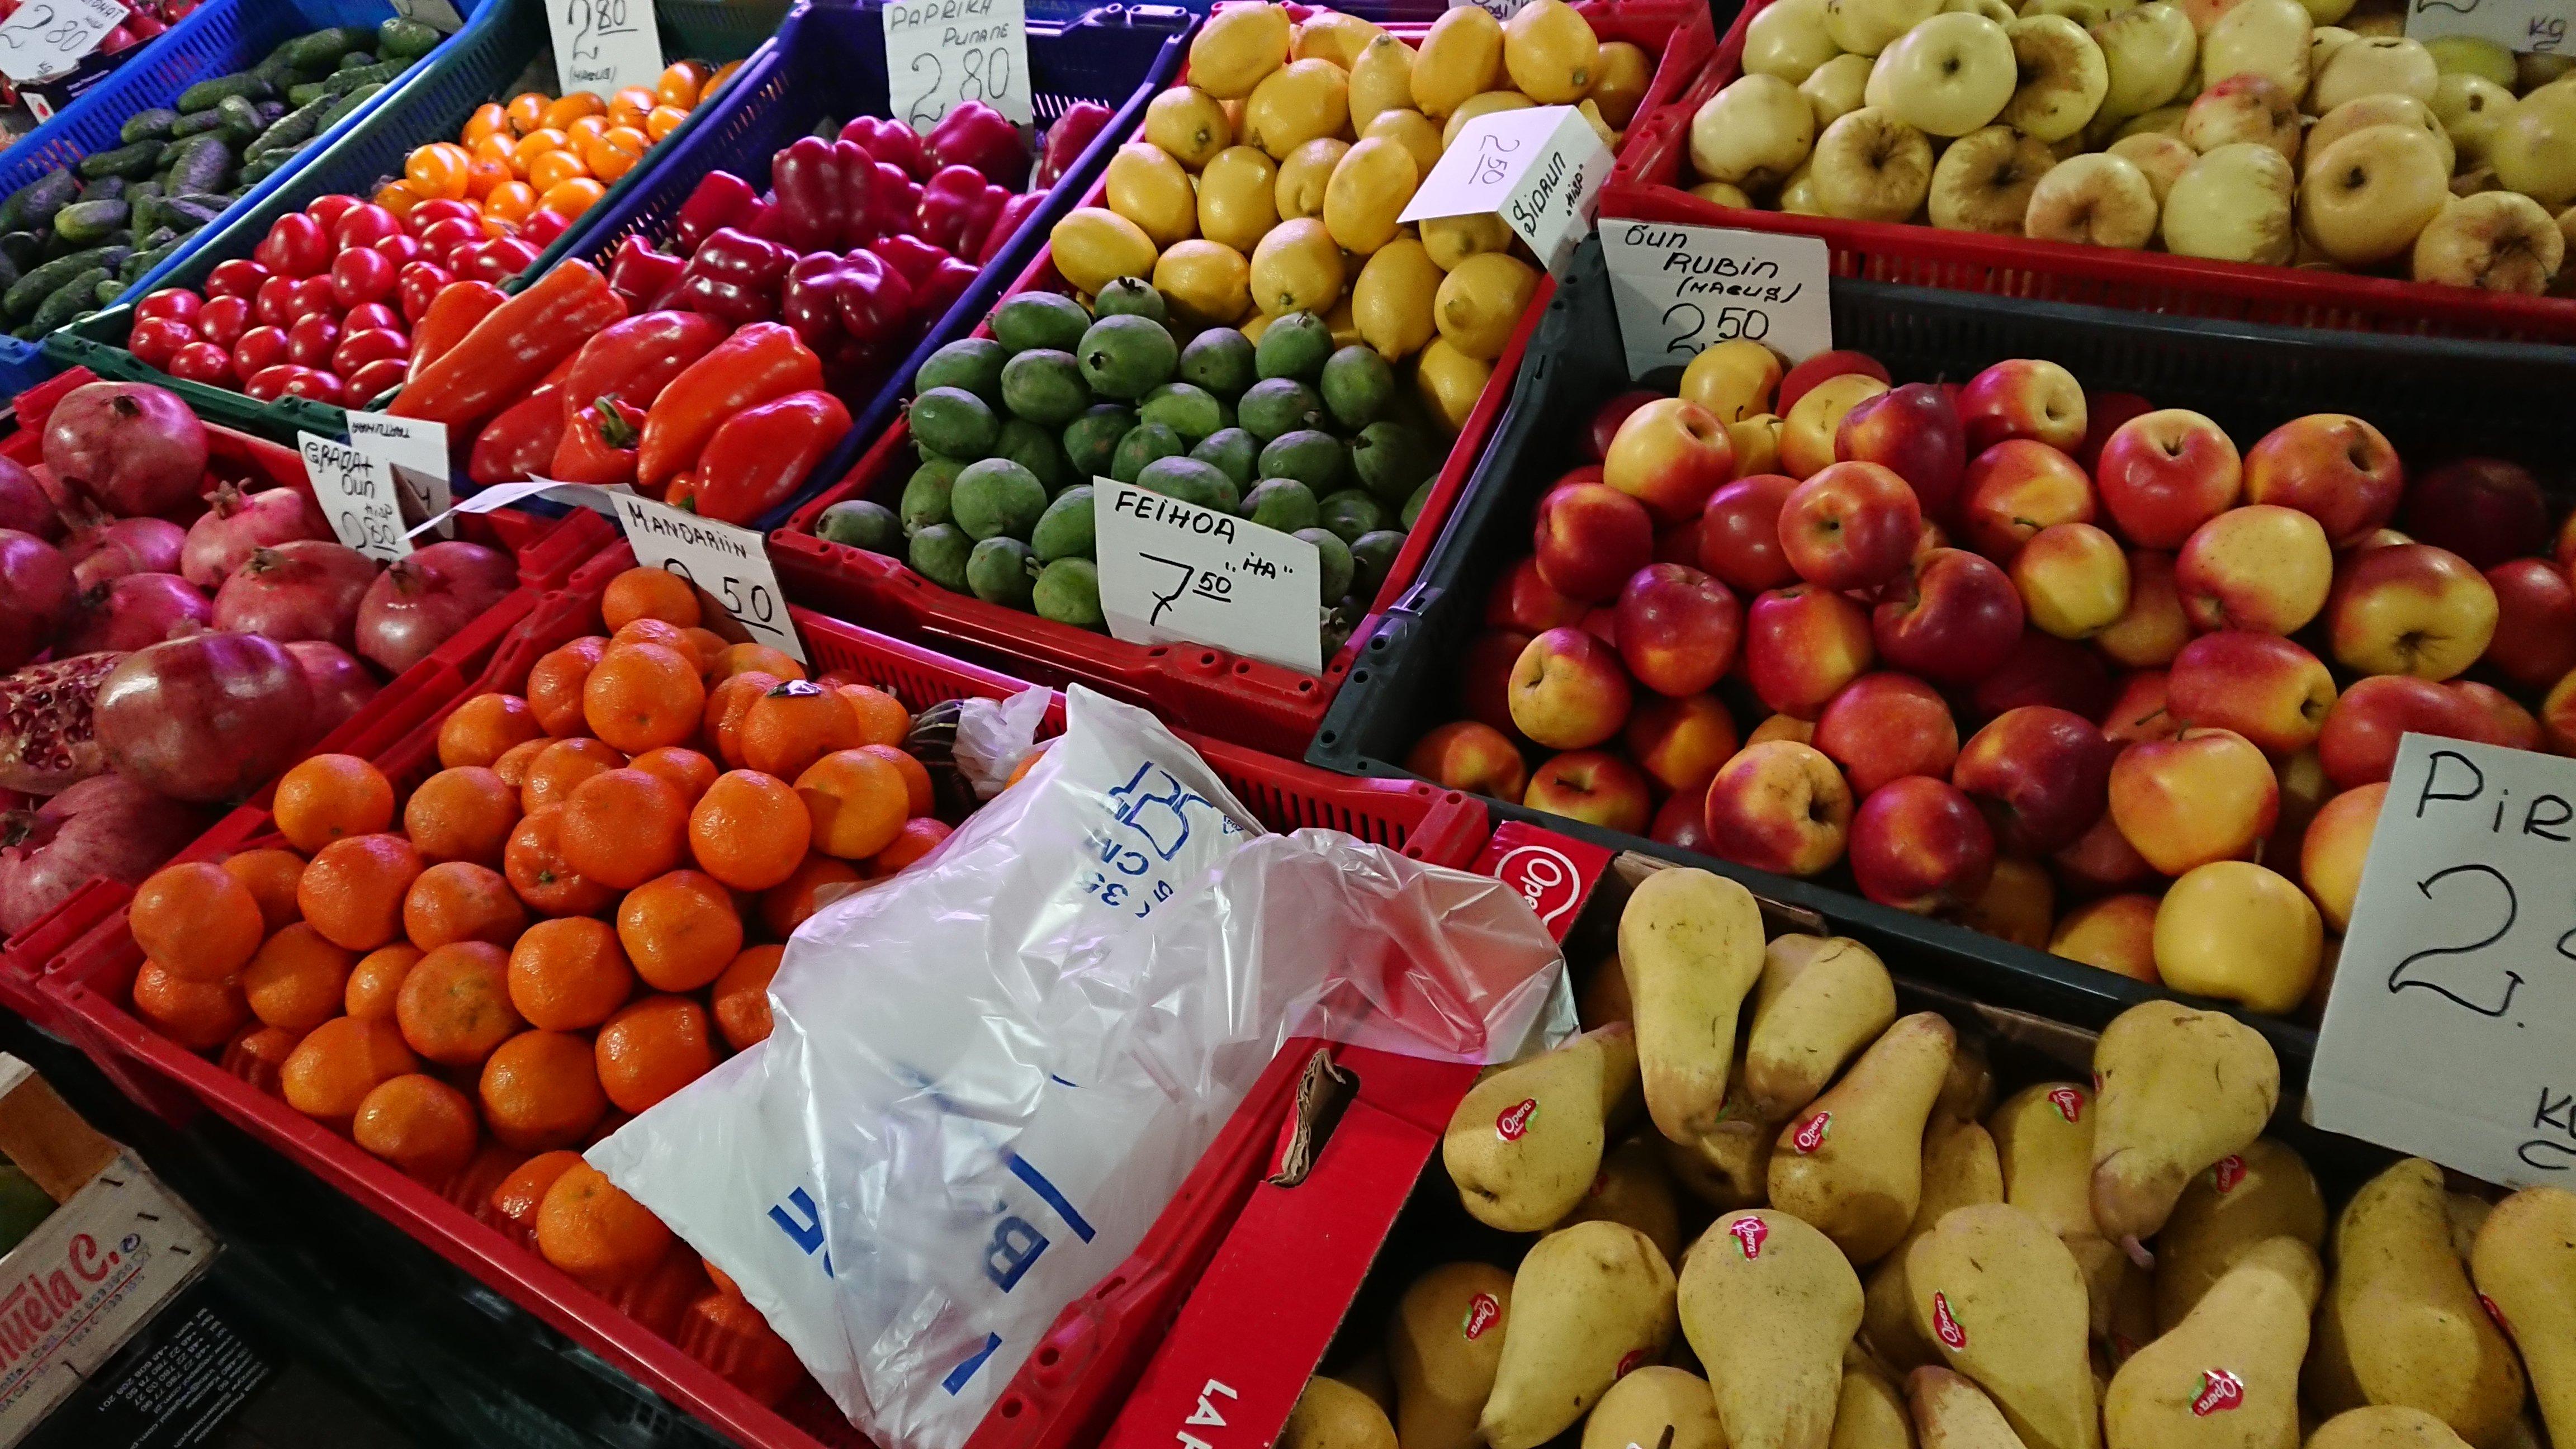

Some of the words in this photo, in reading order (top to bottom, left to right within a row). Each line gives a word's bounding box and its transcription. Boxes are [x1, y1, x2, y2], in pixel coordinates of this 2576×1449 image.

[909, 53, 946, 126] 2
[959, 47, 1010, 101] 80
[1501, 1102, 1532, 1134] Opera
[1798, 1115, 1825, 1148] Opera
[2199, 1378, 2237, 1411] Opera
